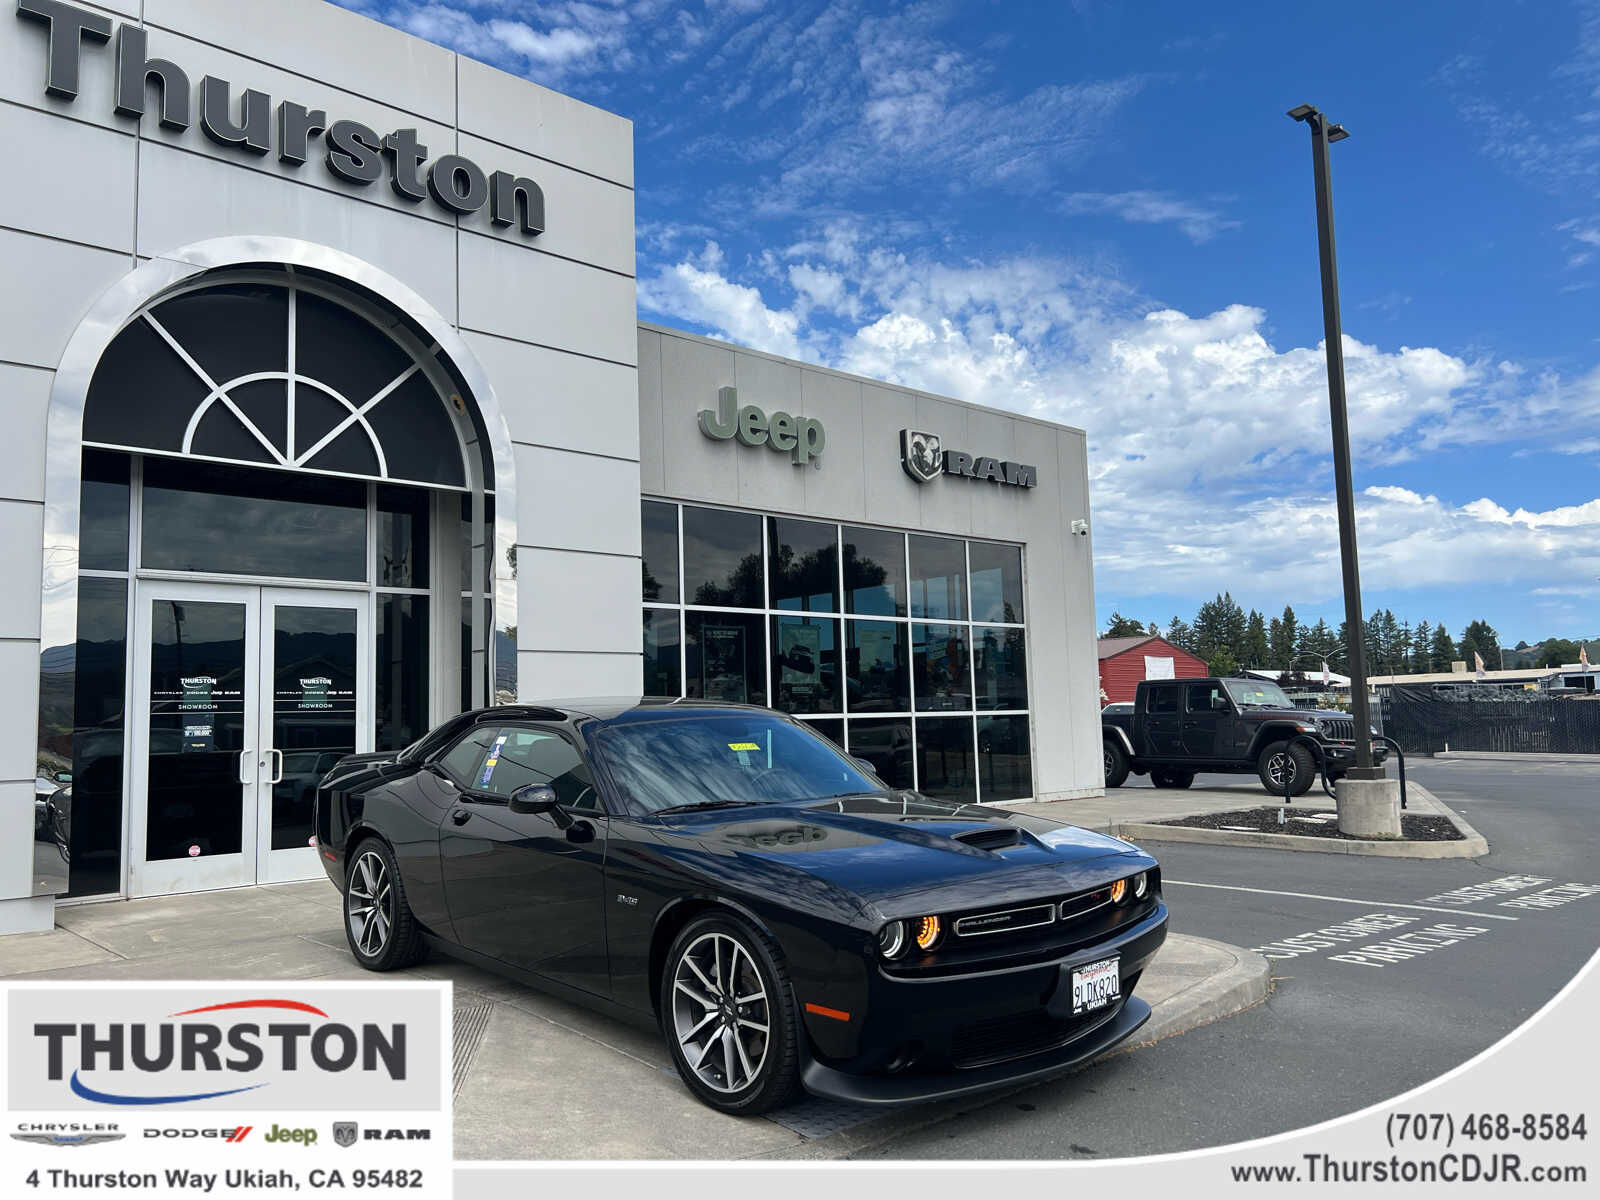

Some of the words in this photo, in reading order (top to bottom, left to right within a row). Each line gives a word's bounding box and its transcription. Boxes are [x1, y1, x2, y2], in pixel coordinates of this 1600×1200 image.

[16, 0, 545, 236] Thurston
[697, 386, 826, 466] Jeep
[942, 450, 1037, 488] RAM
[180, 677, 217, 686] THURSTON
[299, 678, 332, 686] THURSTON
[1250, 913, 1422, 960] CUSTOMER
[1327, 923, 1491, 968] PARKING
[1074, 974, 1118, 1010] 9LDK820
